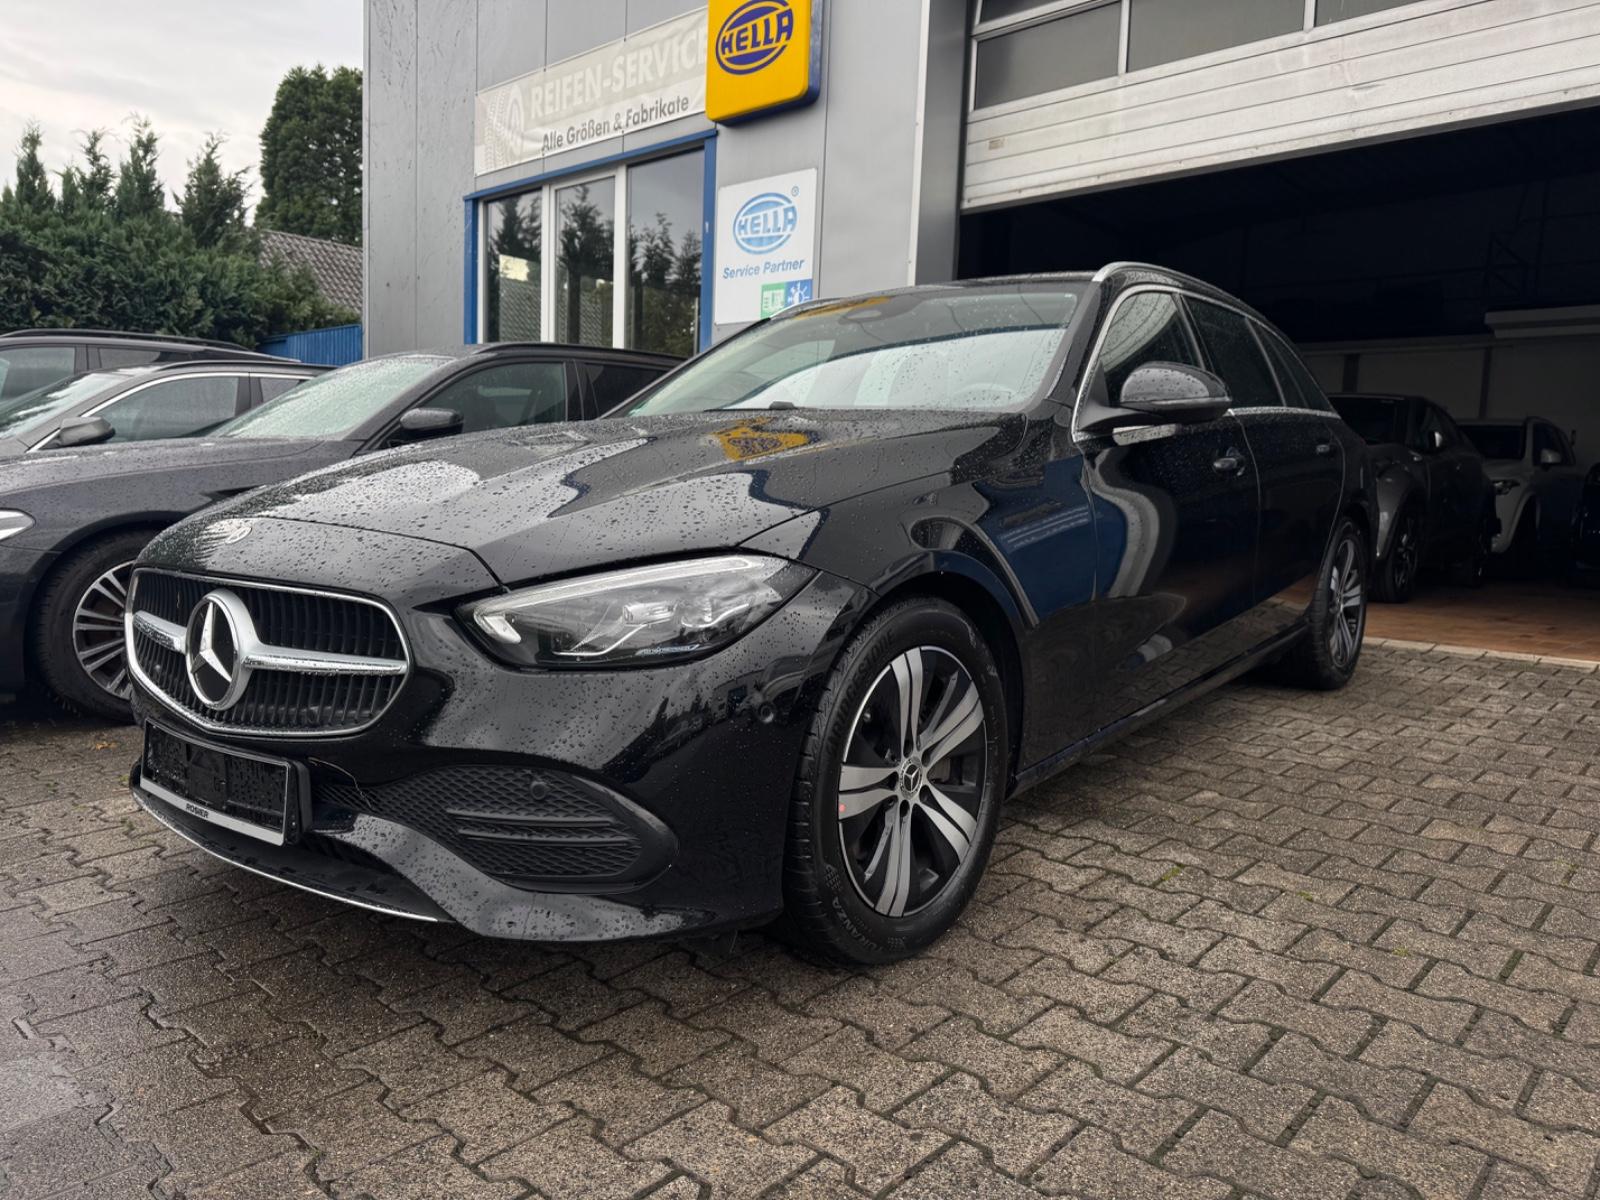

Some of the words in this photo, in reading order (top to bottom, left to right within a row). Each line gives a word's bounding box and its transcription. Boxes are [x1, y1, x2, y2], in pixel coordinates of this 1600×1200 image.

[721, 8, 794, 55] HELLA
[541, 131, 564, 152] Alle
[566, 119, 610, 145] Größen
[613, 112, 622, 130] &
[625, 95, 690, 127] Fabrikate
[737, 205, 797, 236] HELLA
[723, 264, 760, 279] Service
[763, 259, 804, 274] Partner
